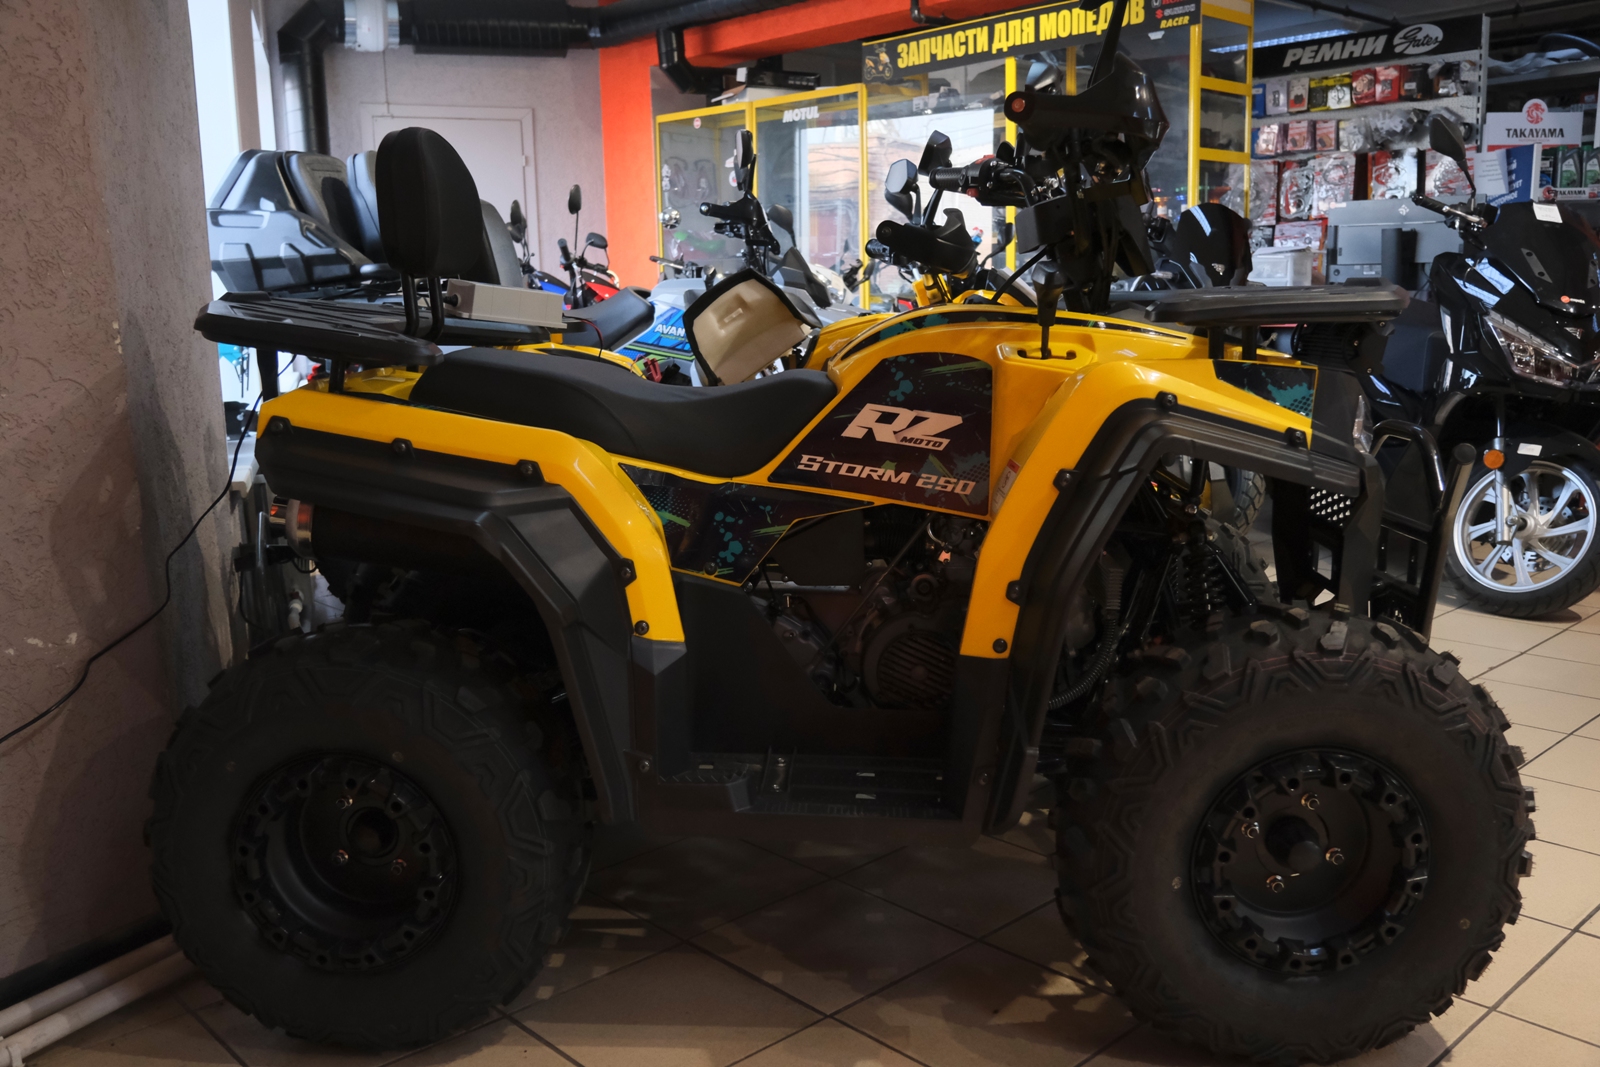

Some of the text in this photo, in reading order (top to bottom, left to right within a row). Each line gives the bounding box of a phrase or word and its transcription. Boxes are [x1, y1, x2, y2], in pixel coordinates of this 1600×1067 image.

[1160, 15, 1190, 29] RACER
[897, 26, 989, 69] ЗАПЧАСТИ
[991, 16, 1035, 54] ДЛЯ
[1282, 34, 1388, 68] РЕМНИ
[1396, 26, 1440, 53] Gates
[782, 106, 820, 123] MOTUL
[1505, 128, 1565, 138] TAKAYAMA
[841, 403, 963, 451] RZ
[900, 435, 944, 449] MOTO
[915, 473, 977, 496] 250
